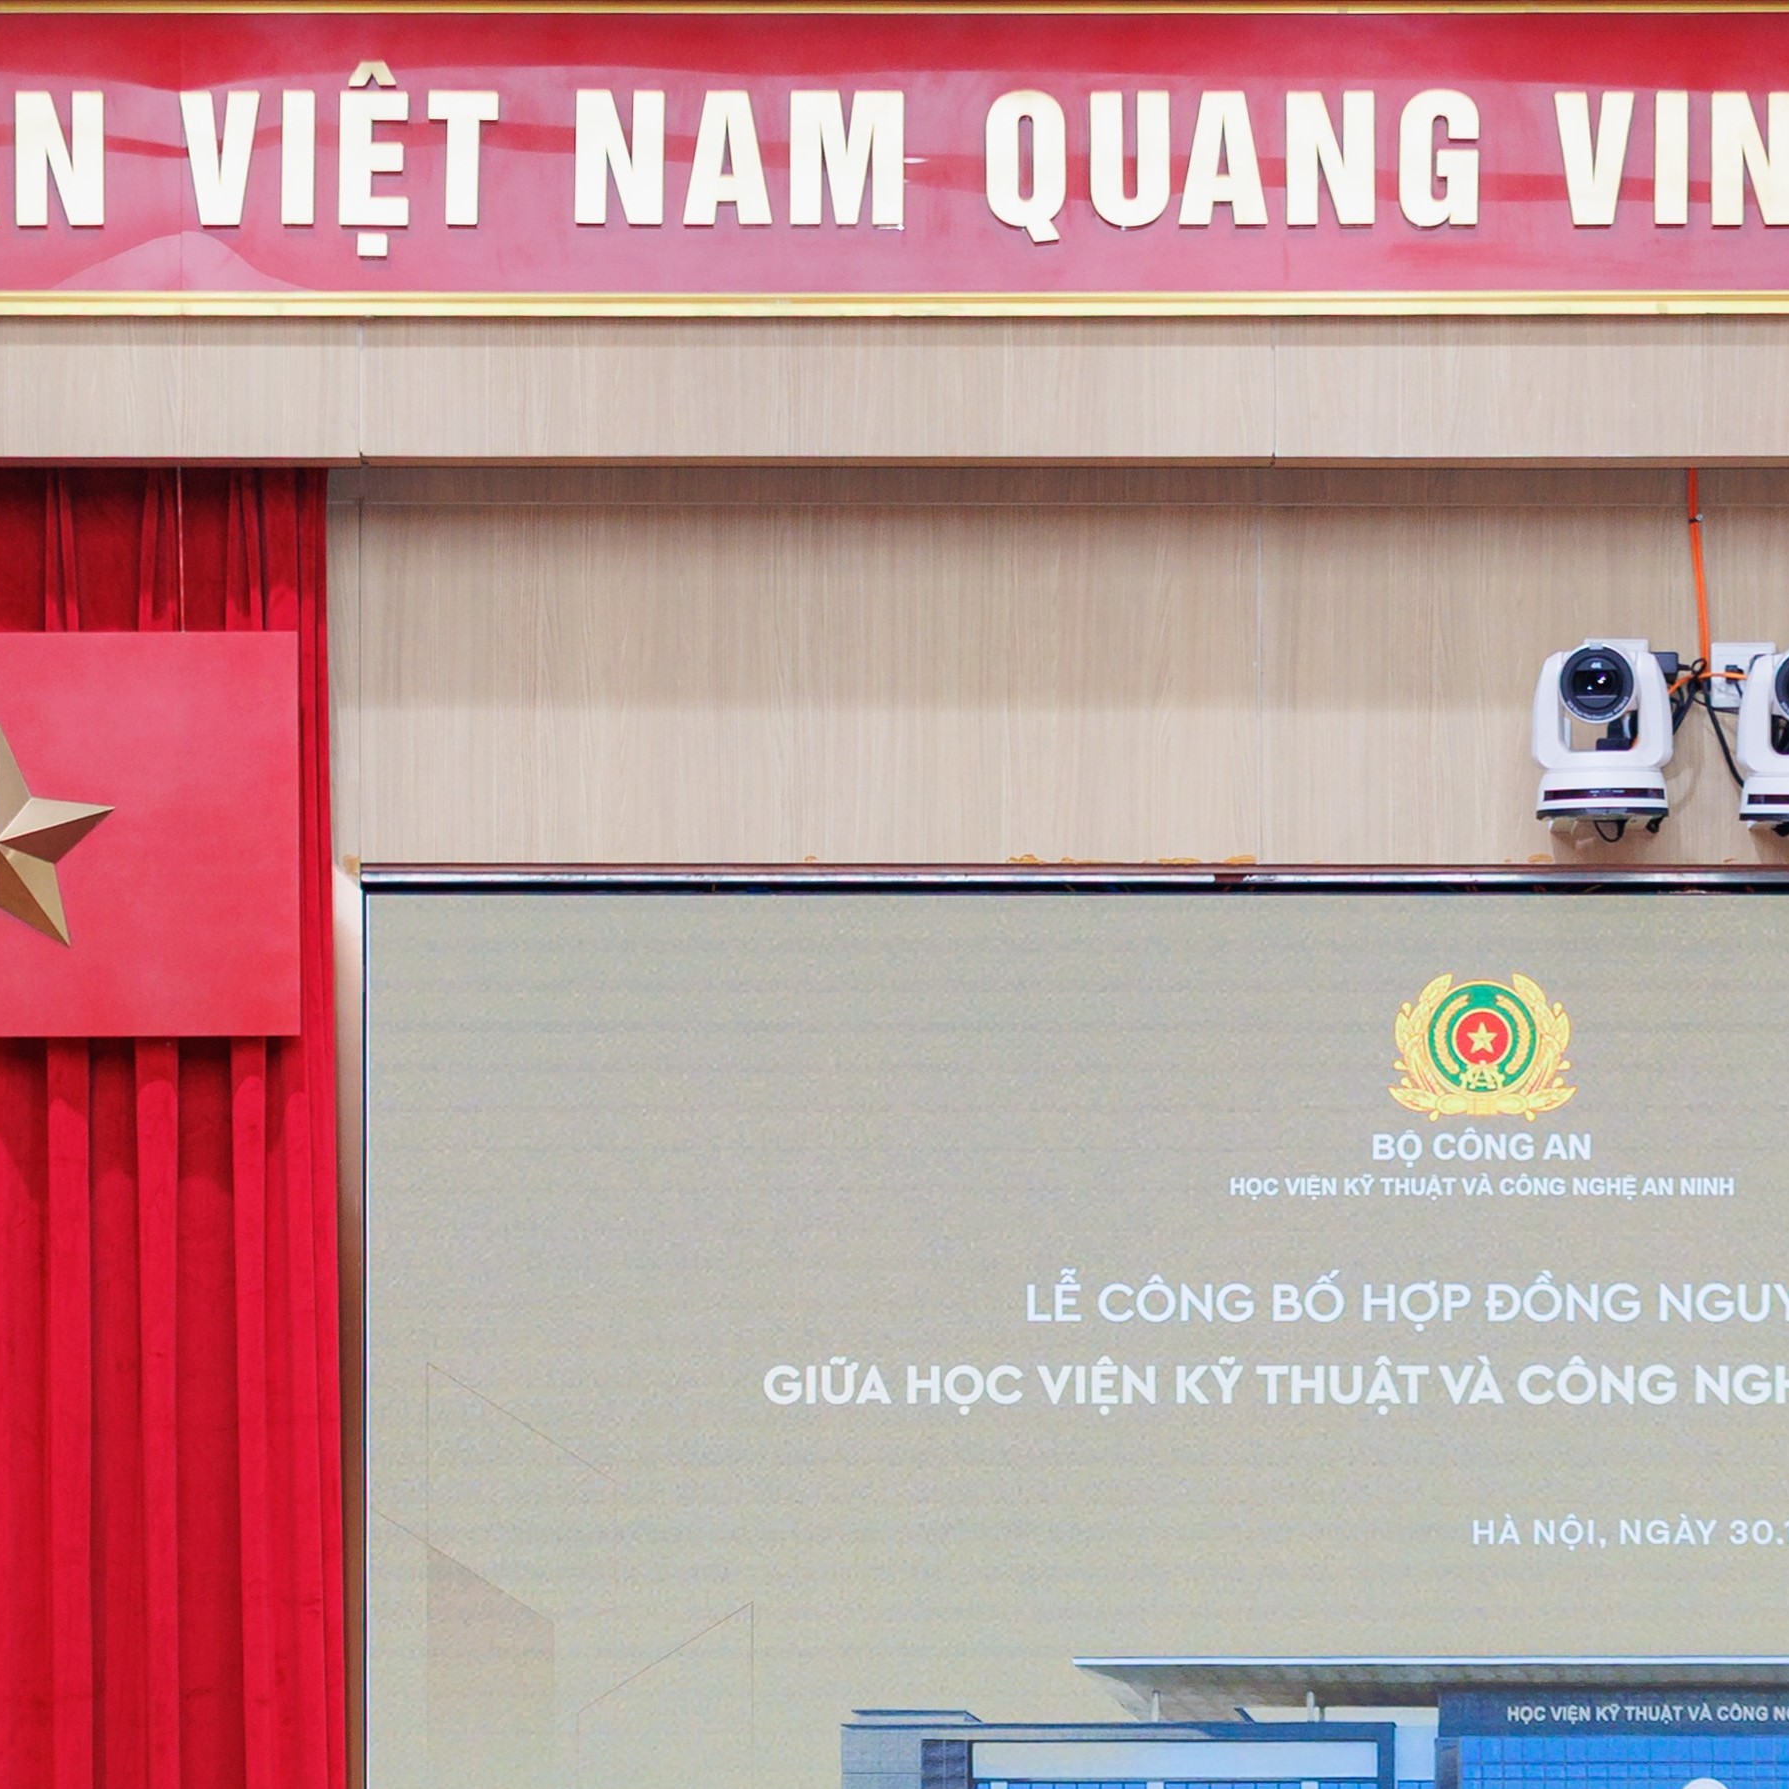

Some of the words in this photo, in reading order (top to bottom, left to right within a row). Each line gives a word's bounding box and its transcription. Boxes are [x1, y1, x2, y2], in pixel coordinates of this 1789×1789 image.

[178, 60, 498, 258] VIỆT
[571, 86, 907, 230] NAM
[984, 86, 1479, 245] QUANG
[1373, 1129, 1423, 1169] BỘ
[1433, 1126, 1534, 1161] CÔNG
[1543, 1133, 1591, 1161] AN
[1230, 1176, 1279, 1201] HỌC
[1285, 1174, 1337, 1201] VIỆN
[1344, 1173, 1374, 1196] KỸ
[1380, 1174, 1456, 1201] THUẬT
[1461, 1172, 1494, 1196] VÀ
[1499, 1172, 1566, 1196] CÔNG
[1573, 1174, 1637, 1201] NGHỆ
[1642, 1176, 1674, 1196] AN
[1680, 1176, 1735, 1196] NINH
[1026, 1268, 1082, 1323] LỄ
[1098, 1273, 1254, 1323] CÔNG
[1273, 1269, 1345, 1323] BỐ
[1363, 1279, 1472, 1332] HỢP
[1485, 1269, 1641, 1323] ĐỒNG
[763, 1356, 892, 1405] GIỮA
[907, 1364, 1024, 1416] HỌC
[1037, 1355, 1157, 1416] VIỆN
[1176, 1356, 1245, 1405] KỸ
[1256, 1355, 1428, 1416] THUẬT
[1439, 1355, 1505, 1405] VÀ
[1517, 1354, 1677, 1405] CÔNG
[1472, 1513, 1521, 1546] HÀ
[1534, 1513, 1607, 1551] NỘI,
[1620, 1513, 1718, 1546] NGÀY
[1507, 1704, 1546, 1725] HỌC
[1550, 1704, 1591, 1725] VIỆN
[1624, 1704, 1684, 1725] THUẬT
[1688, 1702, 1713, 1722] VÀ
[1717, 1702, 1769, 1722] CÔNG
